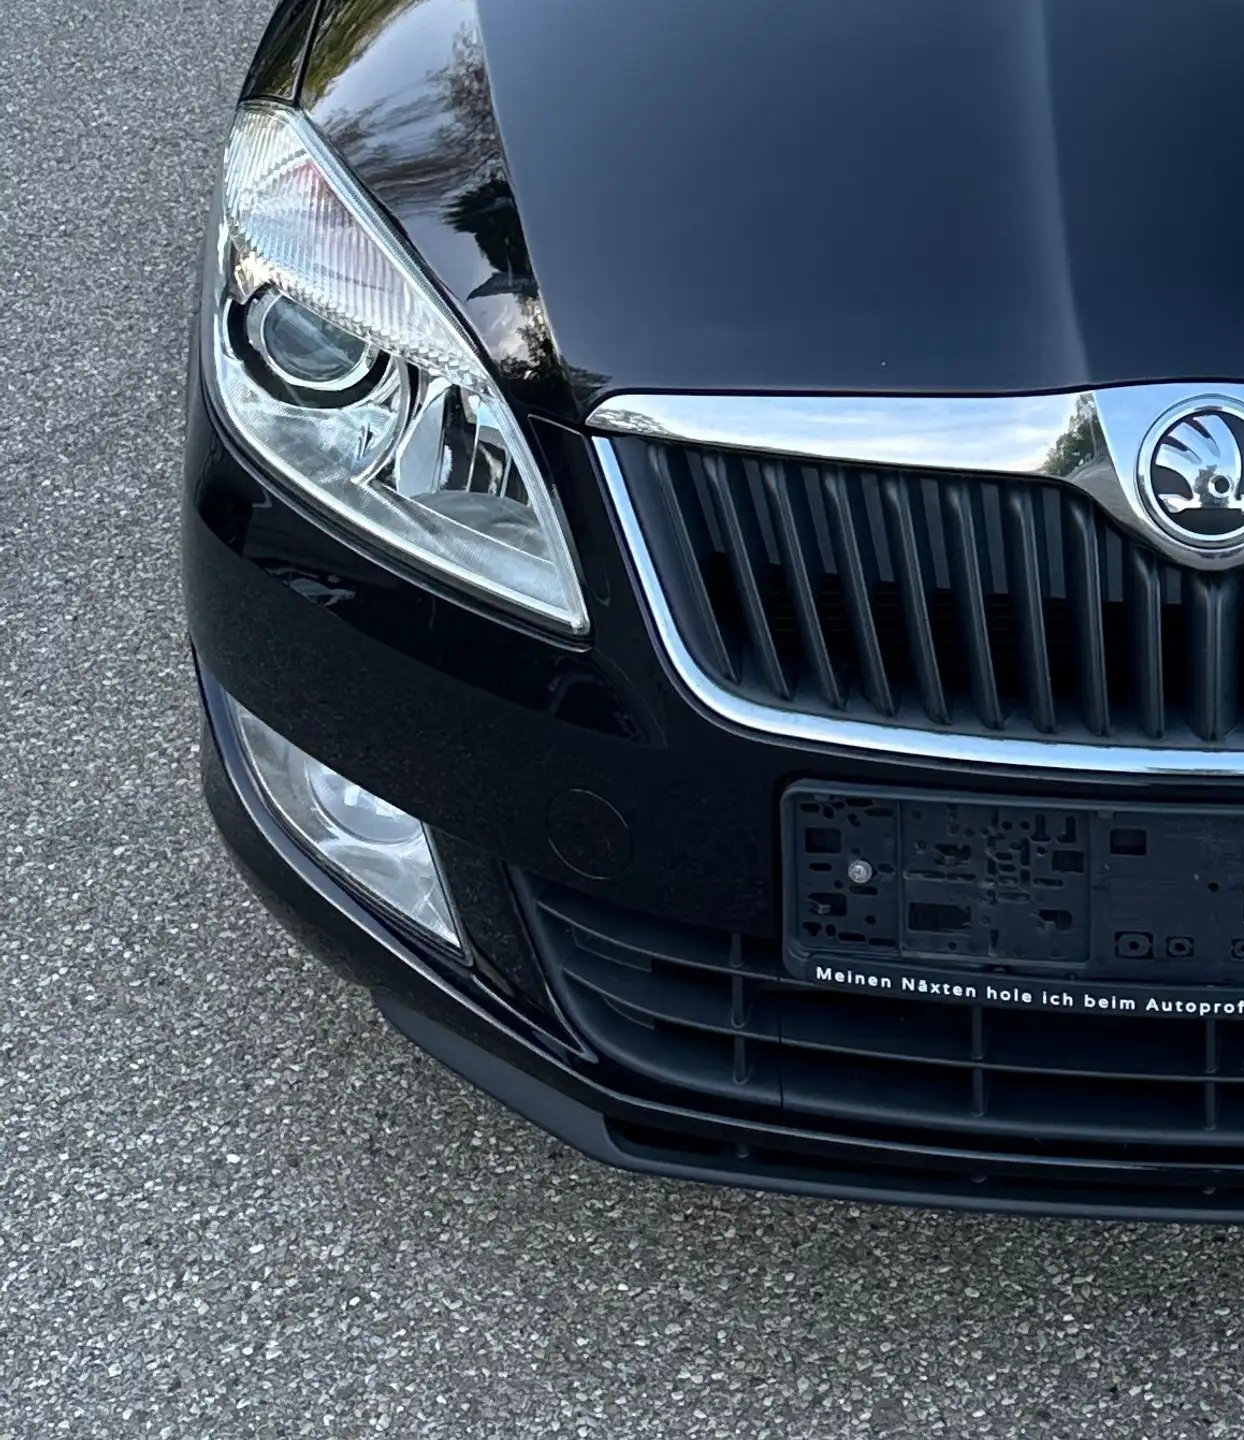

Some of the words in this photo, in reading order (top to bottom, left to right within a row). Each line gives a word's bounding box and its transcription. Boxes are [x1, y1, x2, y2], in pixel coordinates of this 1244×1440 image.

[815, 966, 892, 989] Meinen
[902, 976, 977, 998] Näxten
[986, 985, 1032, 1003] hole
[1041, 990, 1074, 1008] ich
[1084, 993, 1136, 1011] beim
